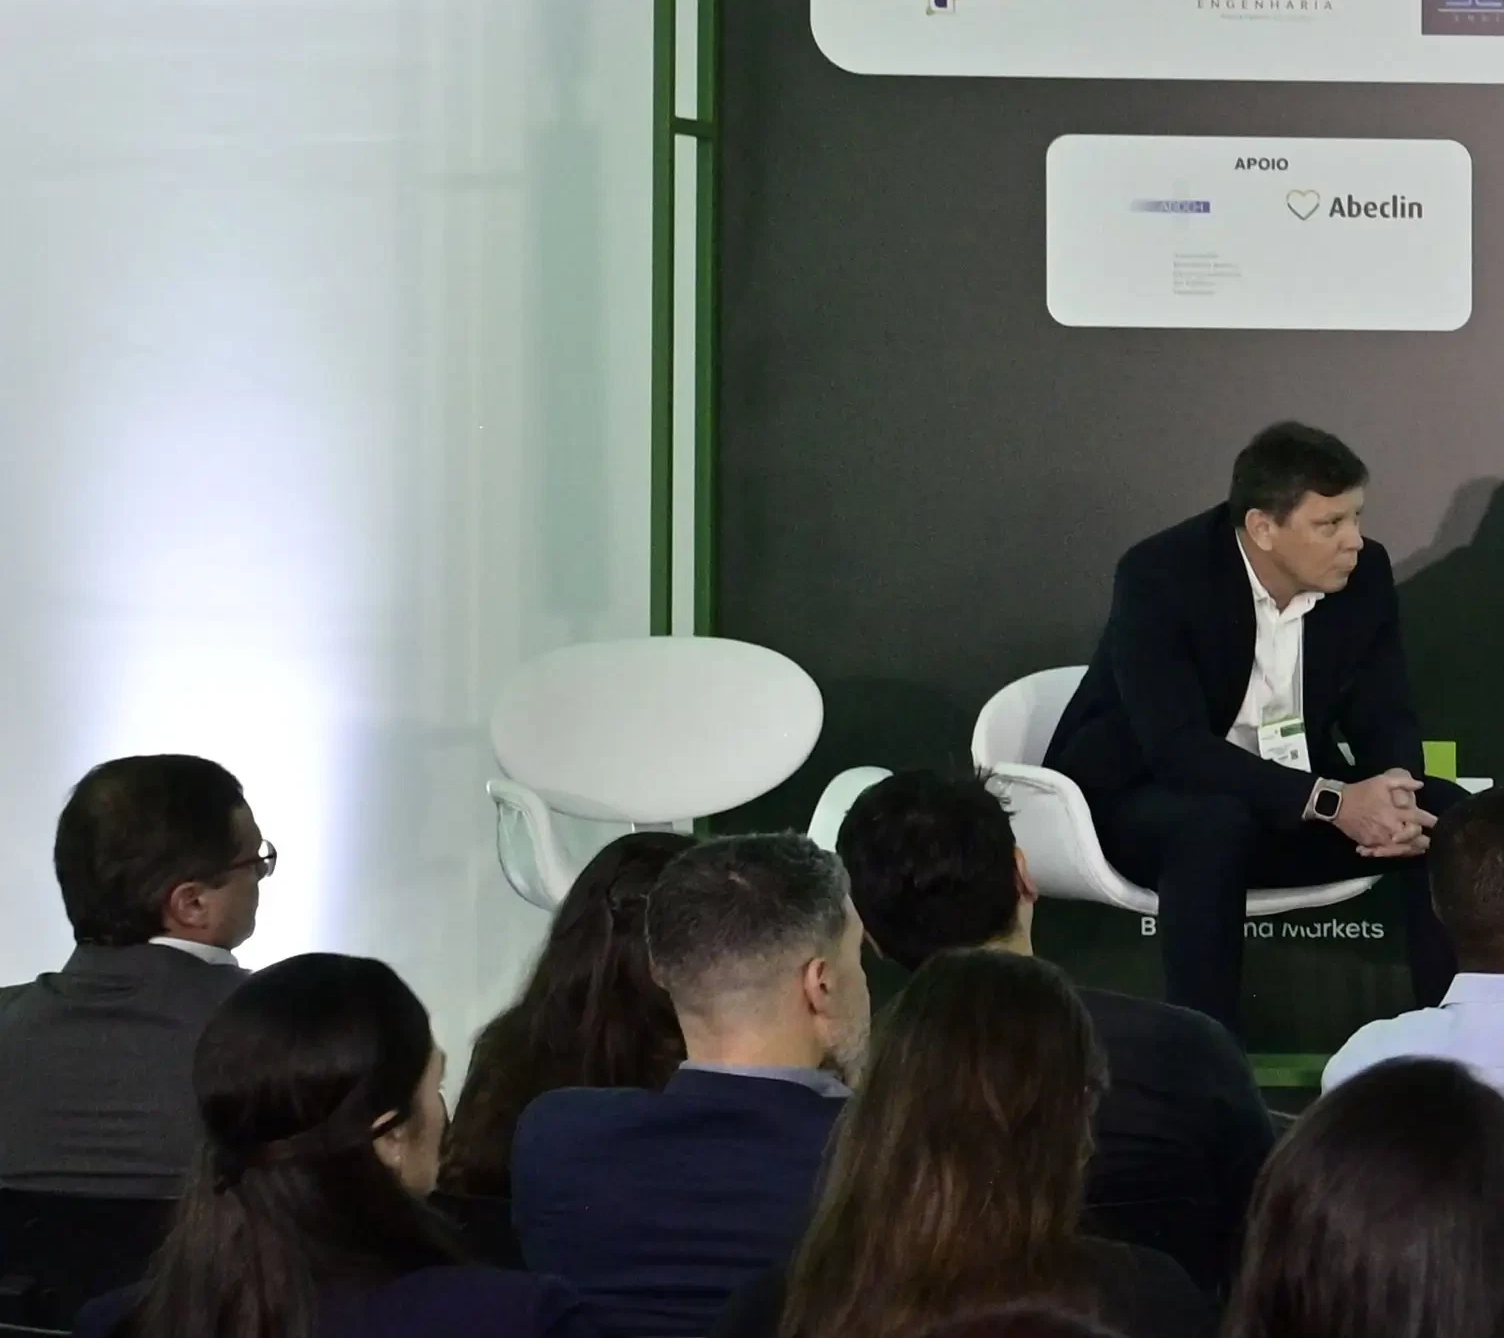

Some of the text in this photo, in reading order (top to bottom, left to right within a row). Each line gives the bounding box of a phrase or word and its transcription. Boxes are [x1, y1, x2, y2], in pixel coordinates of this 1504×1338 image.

[1234, 156, 1289, 172] APOIO
[1328, 194, 1423, 219] Abeclin
[1141, 917, 1158, 936] B
